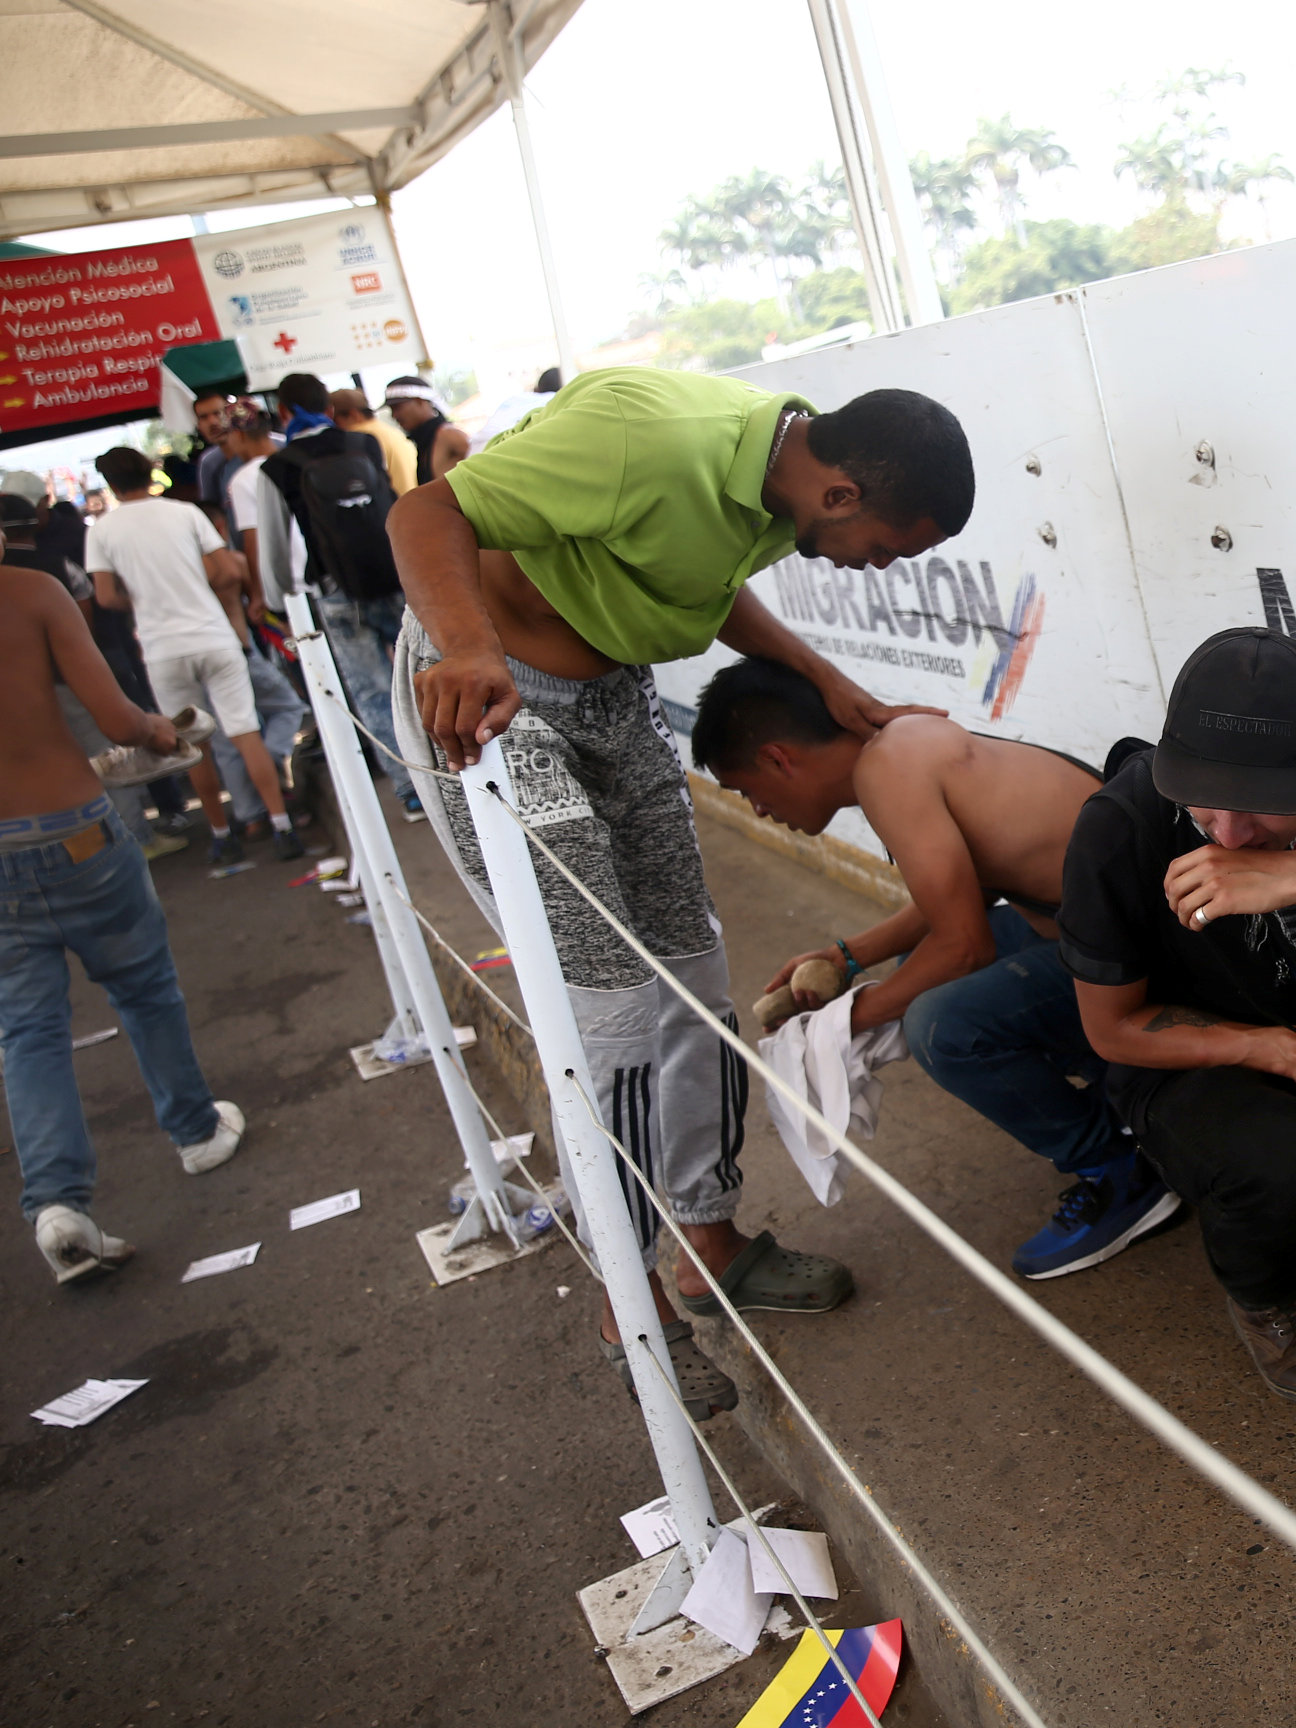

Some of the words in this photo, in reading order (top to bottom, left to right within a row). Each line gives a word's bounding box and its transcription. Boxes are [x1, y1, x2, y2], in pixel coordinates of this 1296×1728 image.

[0, 265, 82, 290] Atención
[87, 255, 159, 280] Médica
[1, 294, 65, 316] Apoyo
[69, 273, 175, 306] Psicosocial
[5, 309, 125, 339] Vacunación
[15, 329, 153, 363] Rehidratación
[157, 317, 202, 342] Oral
[22, 360, 99, 387] Terapia
[33, 375, 149, 410] Ambulancia
[540, 811, 572, 822] YORK
